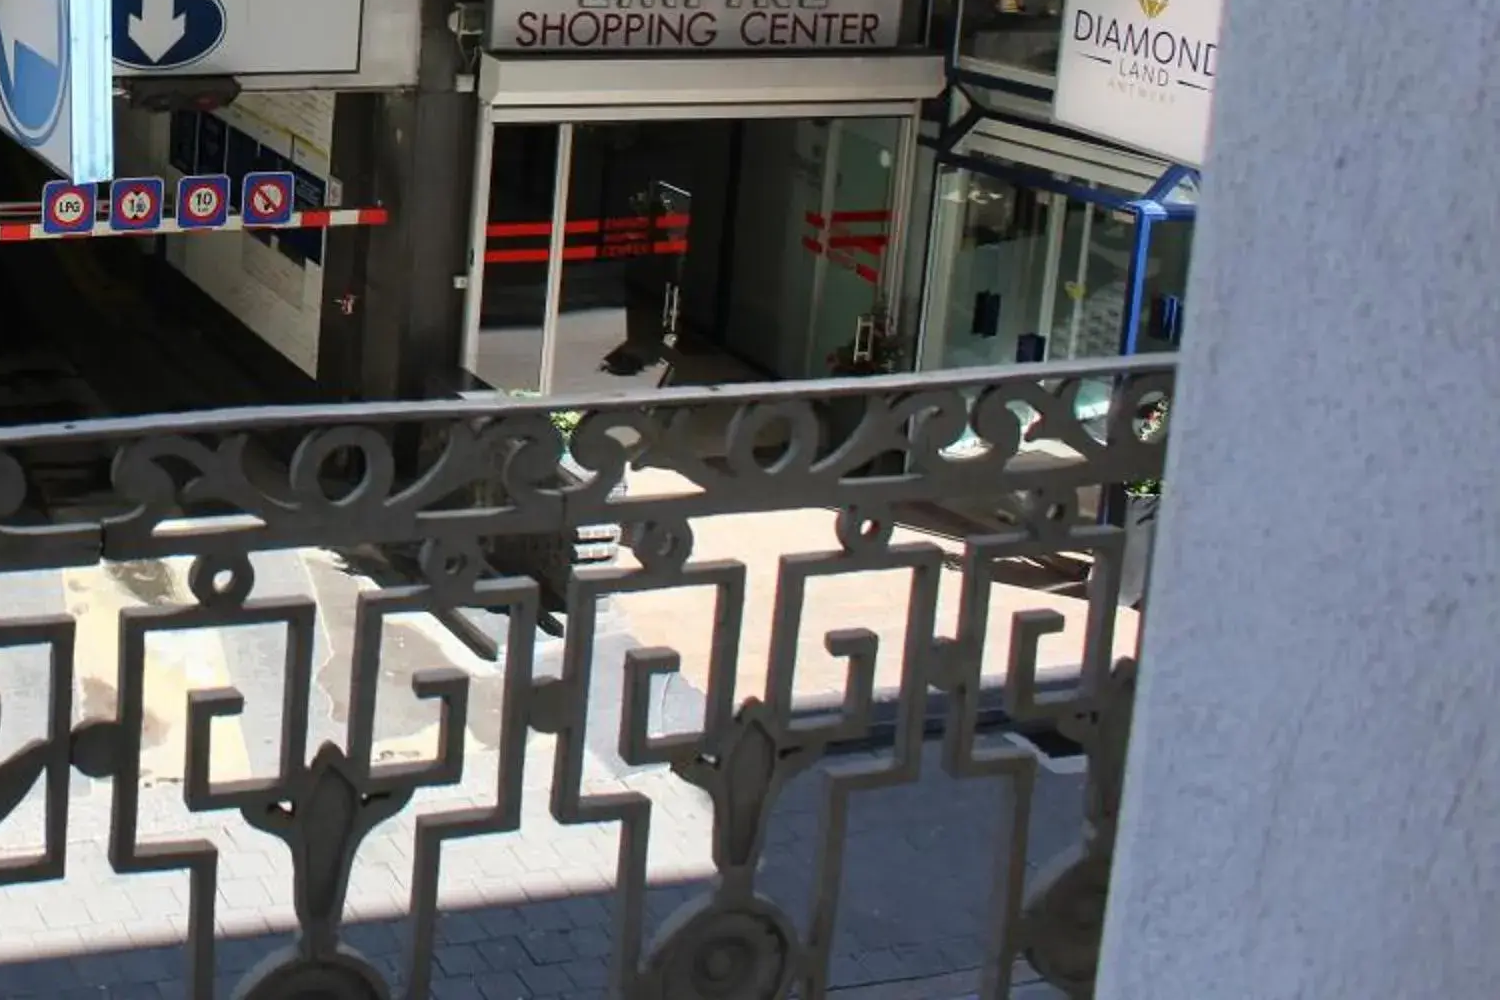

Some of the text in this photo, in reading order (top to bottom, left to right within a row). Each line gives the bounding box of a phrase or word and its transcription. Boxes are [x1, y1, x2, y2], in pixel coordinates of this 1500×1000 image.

[515, 10, 880, 48] SHOPPING CENTER
[1118, 57, 1170, 87] LAND
[59, 201, 81, 213] LPG
